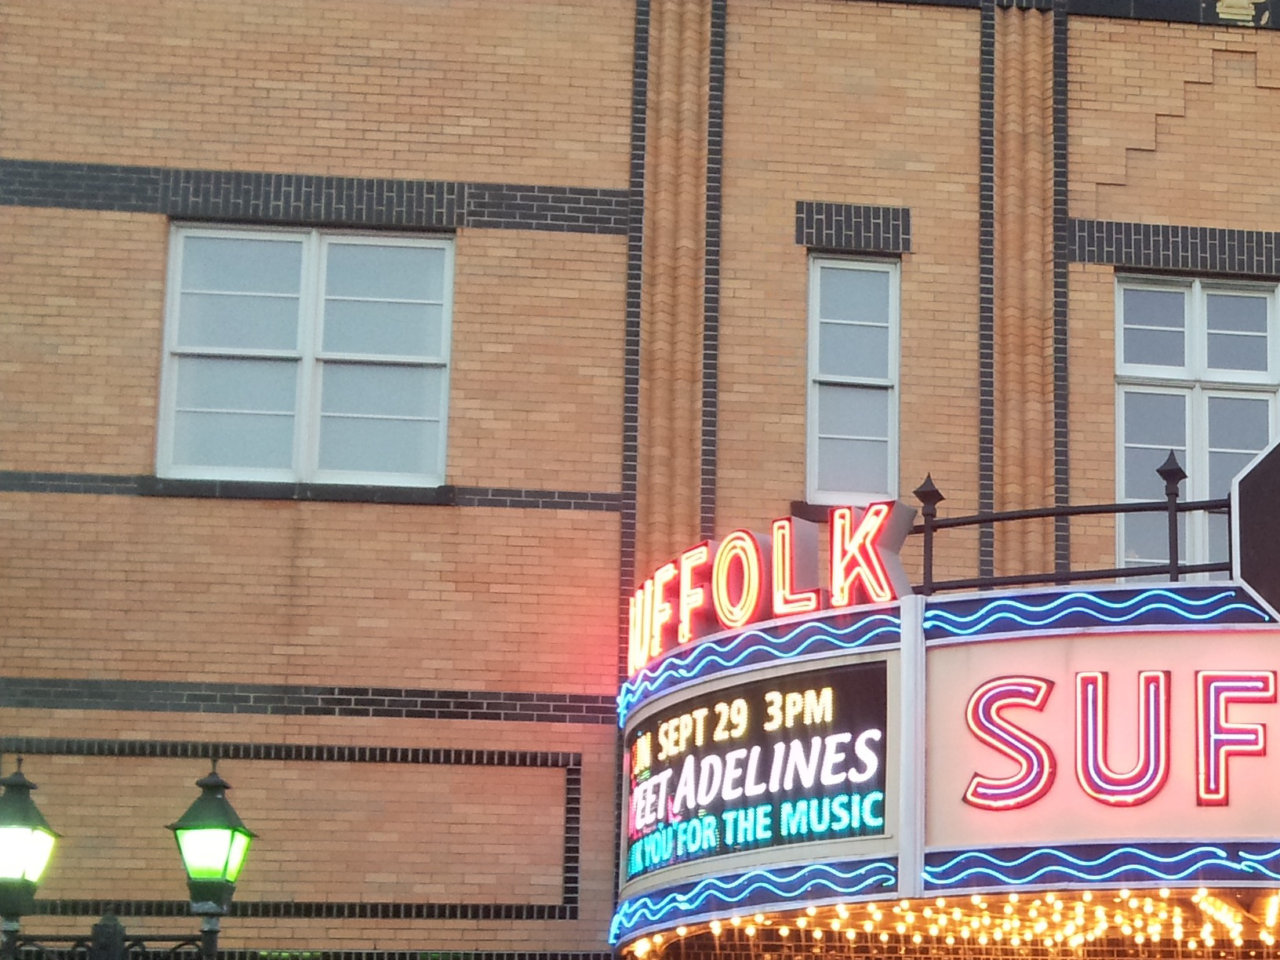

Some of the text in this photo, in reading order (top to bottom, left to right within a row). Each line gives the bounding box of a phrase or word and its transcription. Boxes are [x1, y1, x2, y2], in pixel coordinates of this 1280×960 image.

[628, 499, 895, 676] UFFOLK
[657, 707, 708, 761] SEPT
[713, 698, 748, 742] 29
[763, 687, 834, 732] 3PM
[633, 728, 882, 830] EET ADELINES
[643, 824, 673, 866] YOU
[677, 813, 717, 856] FOR
[722, 804, 772, 845] THE
[781, 791, 884, 836] MUSIC
